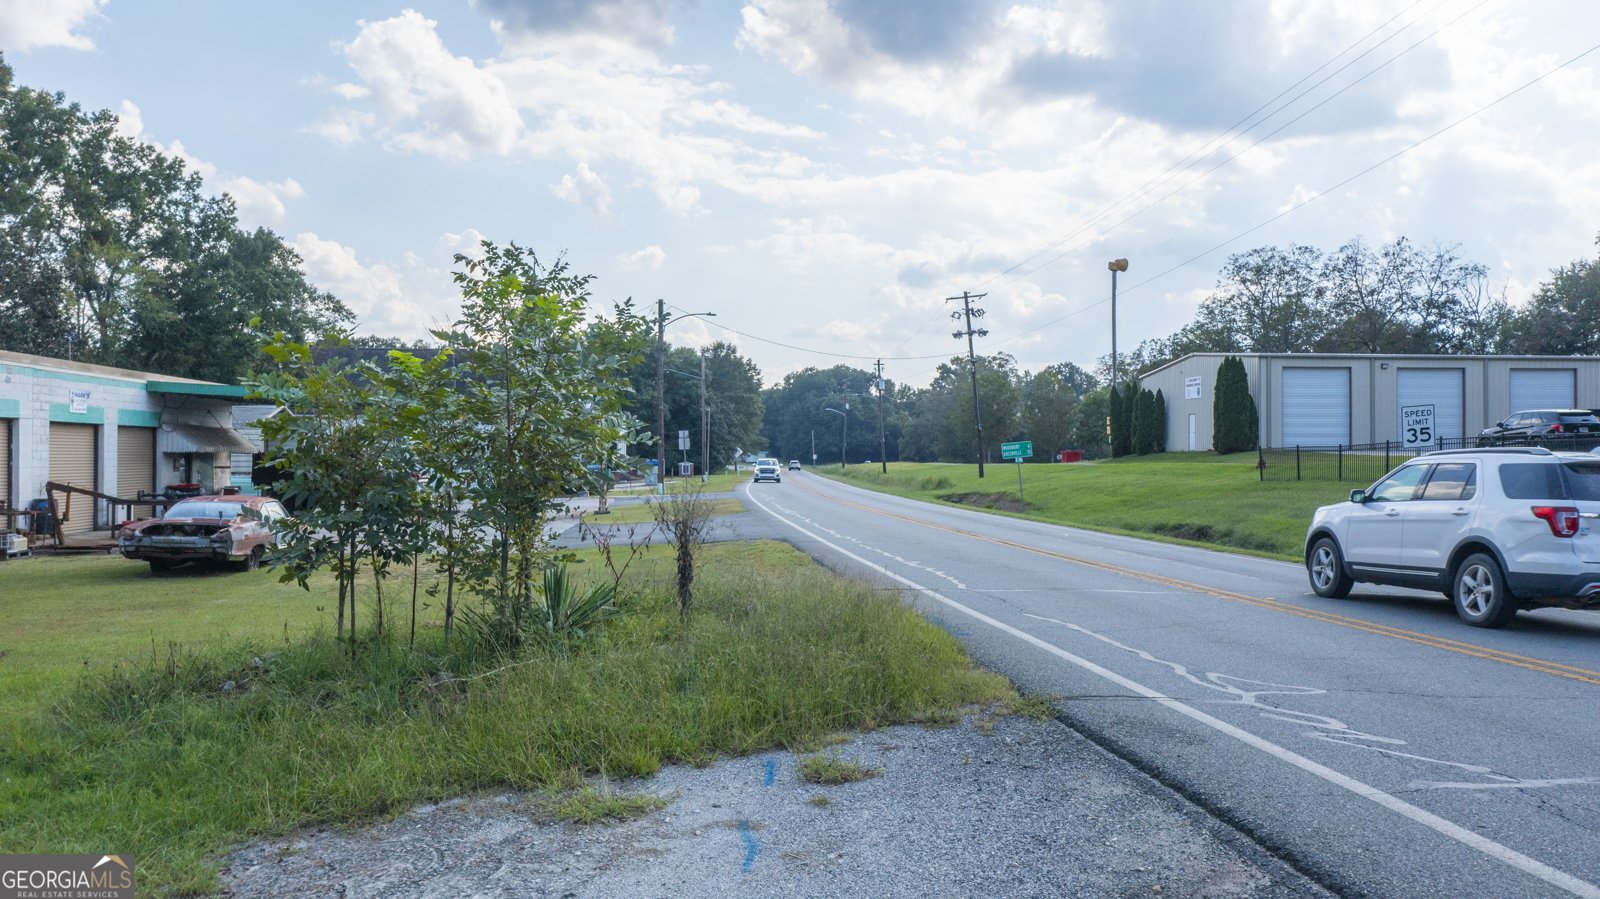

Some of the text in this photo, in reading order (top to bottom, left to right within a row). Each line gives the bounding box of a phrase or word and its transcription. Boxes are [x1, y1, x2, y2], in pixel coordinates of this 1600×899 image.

[1404, 409, 1432, 418] SPEED
[1408, 418, 1428, 426] LIMIT
[1406, 427, 1432, 443] 35
